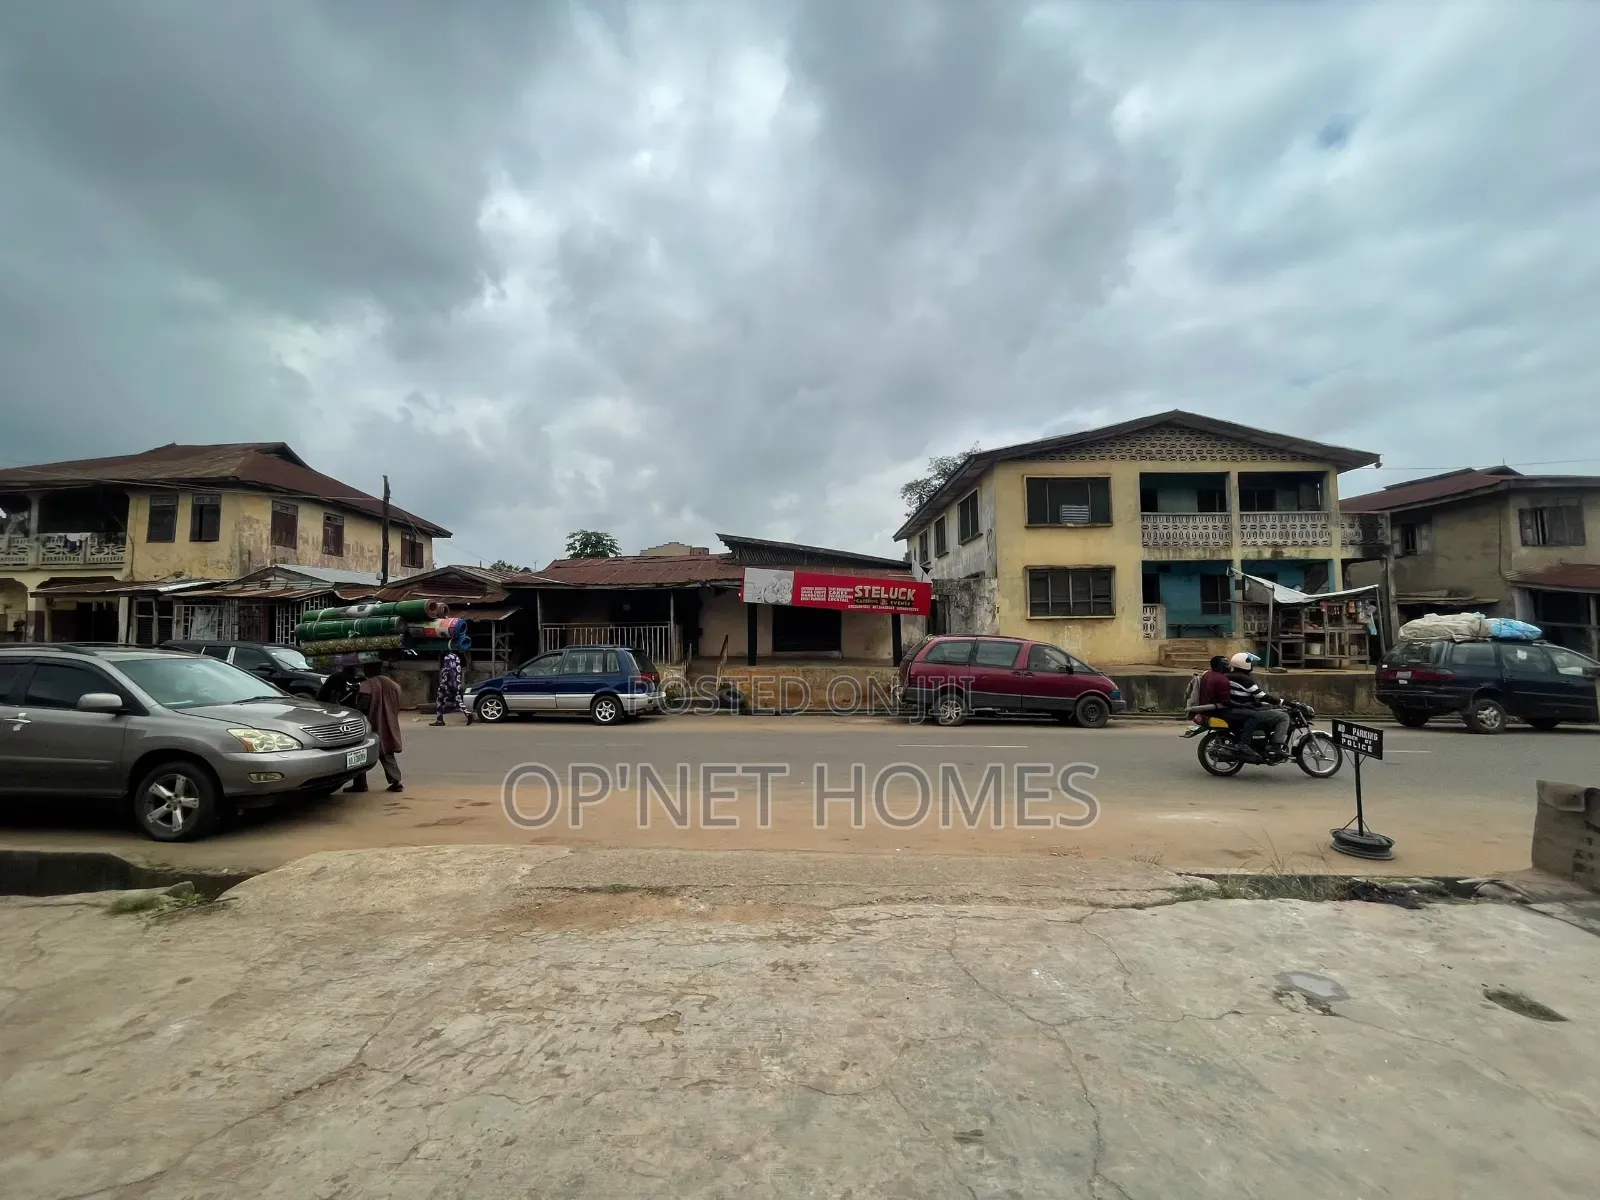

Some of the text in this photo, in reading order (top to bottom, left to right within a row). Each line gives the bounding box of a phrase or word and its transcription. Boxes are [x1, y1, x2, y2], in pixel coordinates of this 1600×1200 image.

[854, 585, 916, 601] STELUCK
[1352, 727, 1378, 741] PARKING
[1341, 737, 1373, 753] POLICE
